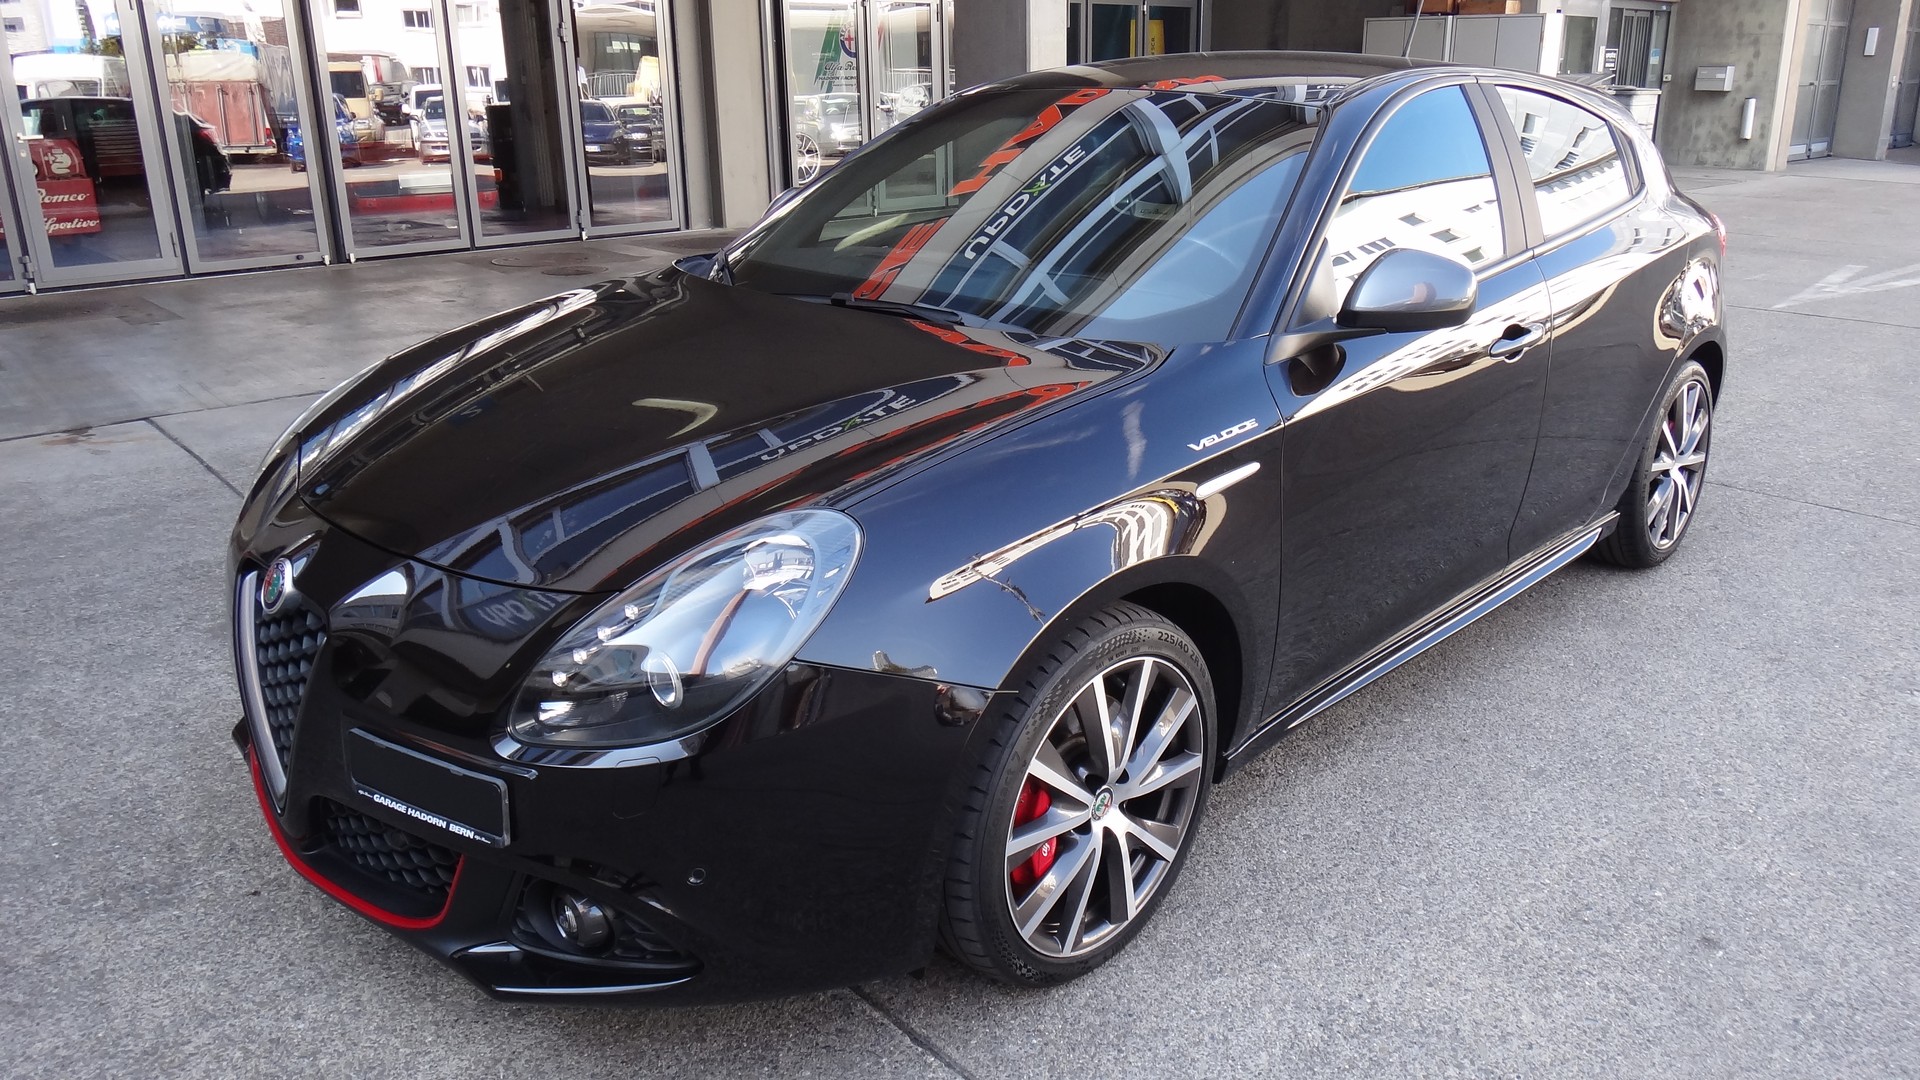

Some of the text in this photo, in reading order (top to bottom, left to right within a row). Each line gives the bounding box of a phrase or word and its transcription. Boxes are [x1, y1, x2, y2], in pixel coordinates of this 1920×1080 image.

[1186, 418, 1259, 451] VELOCE
[1157, 631, 1190, 654] 225/40
[373, 794, 408, 814] GARAGE
[407, 807, 447, 829] HADORN
[449, 823, 474, 839] BERN
